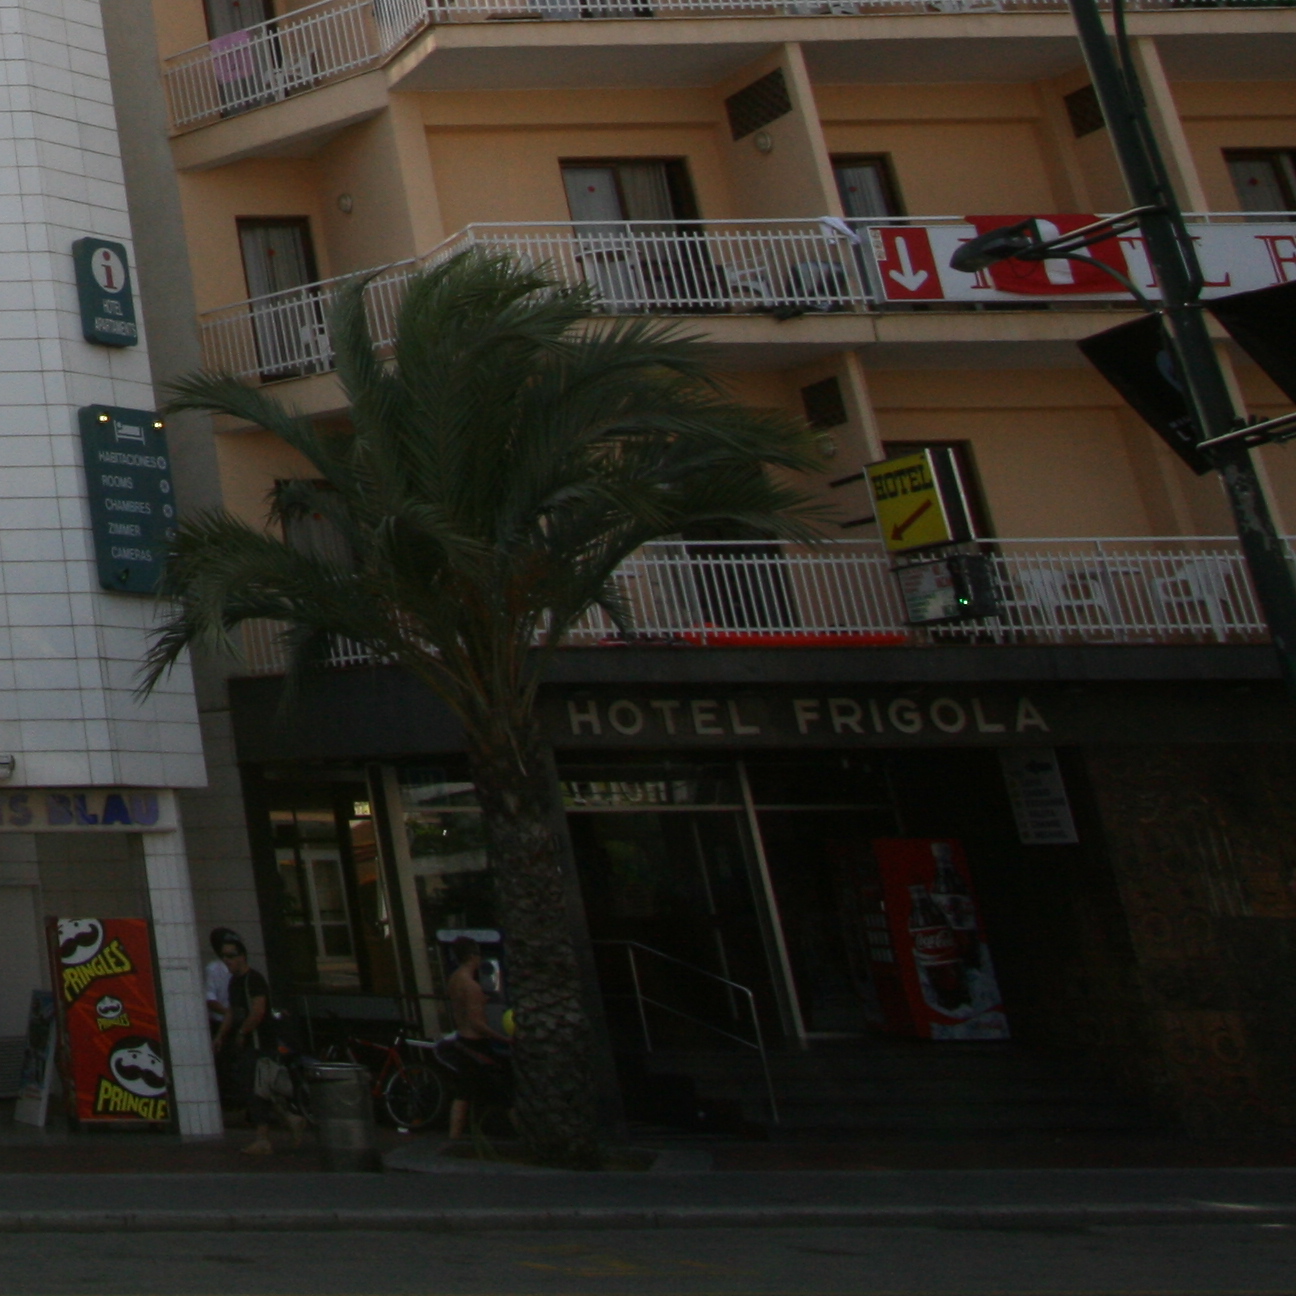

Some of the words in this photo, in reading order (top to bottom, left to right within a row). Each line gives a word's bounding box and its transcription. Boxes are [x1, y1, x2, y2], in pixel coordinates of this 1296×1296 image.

[97, 451, 157, 468] HABITACIONES
[101, 474, 134, 490] ROOMS
[871, 464, 934, 501] HOTEL
[104, 497, 152, 515] CHAMBRES
[107, 522, 142, 537] ZIMMER
[566, 699, 761, 736] HOTEL
[792, 697, 1052, 735] FRIGOLA
[43, 792, 160, 827] BLAU
[62, 939, 133, 1003] PRINGLES
[97, 1013, 131, 1032] PRINGLES
